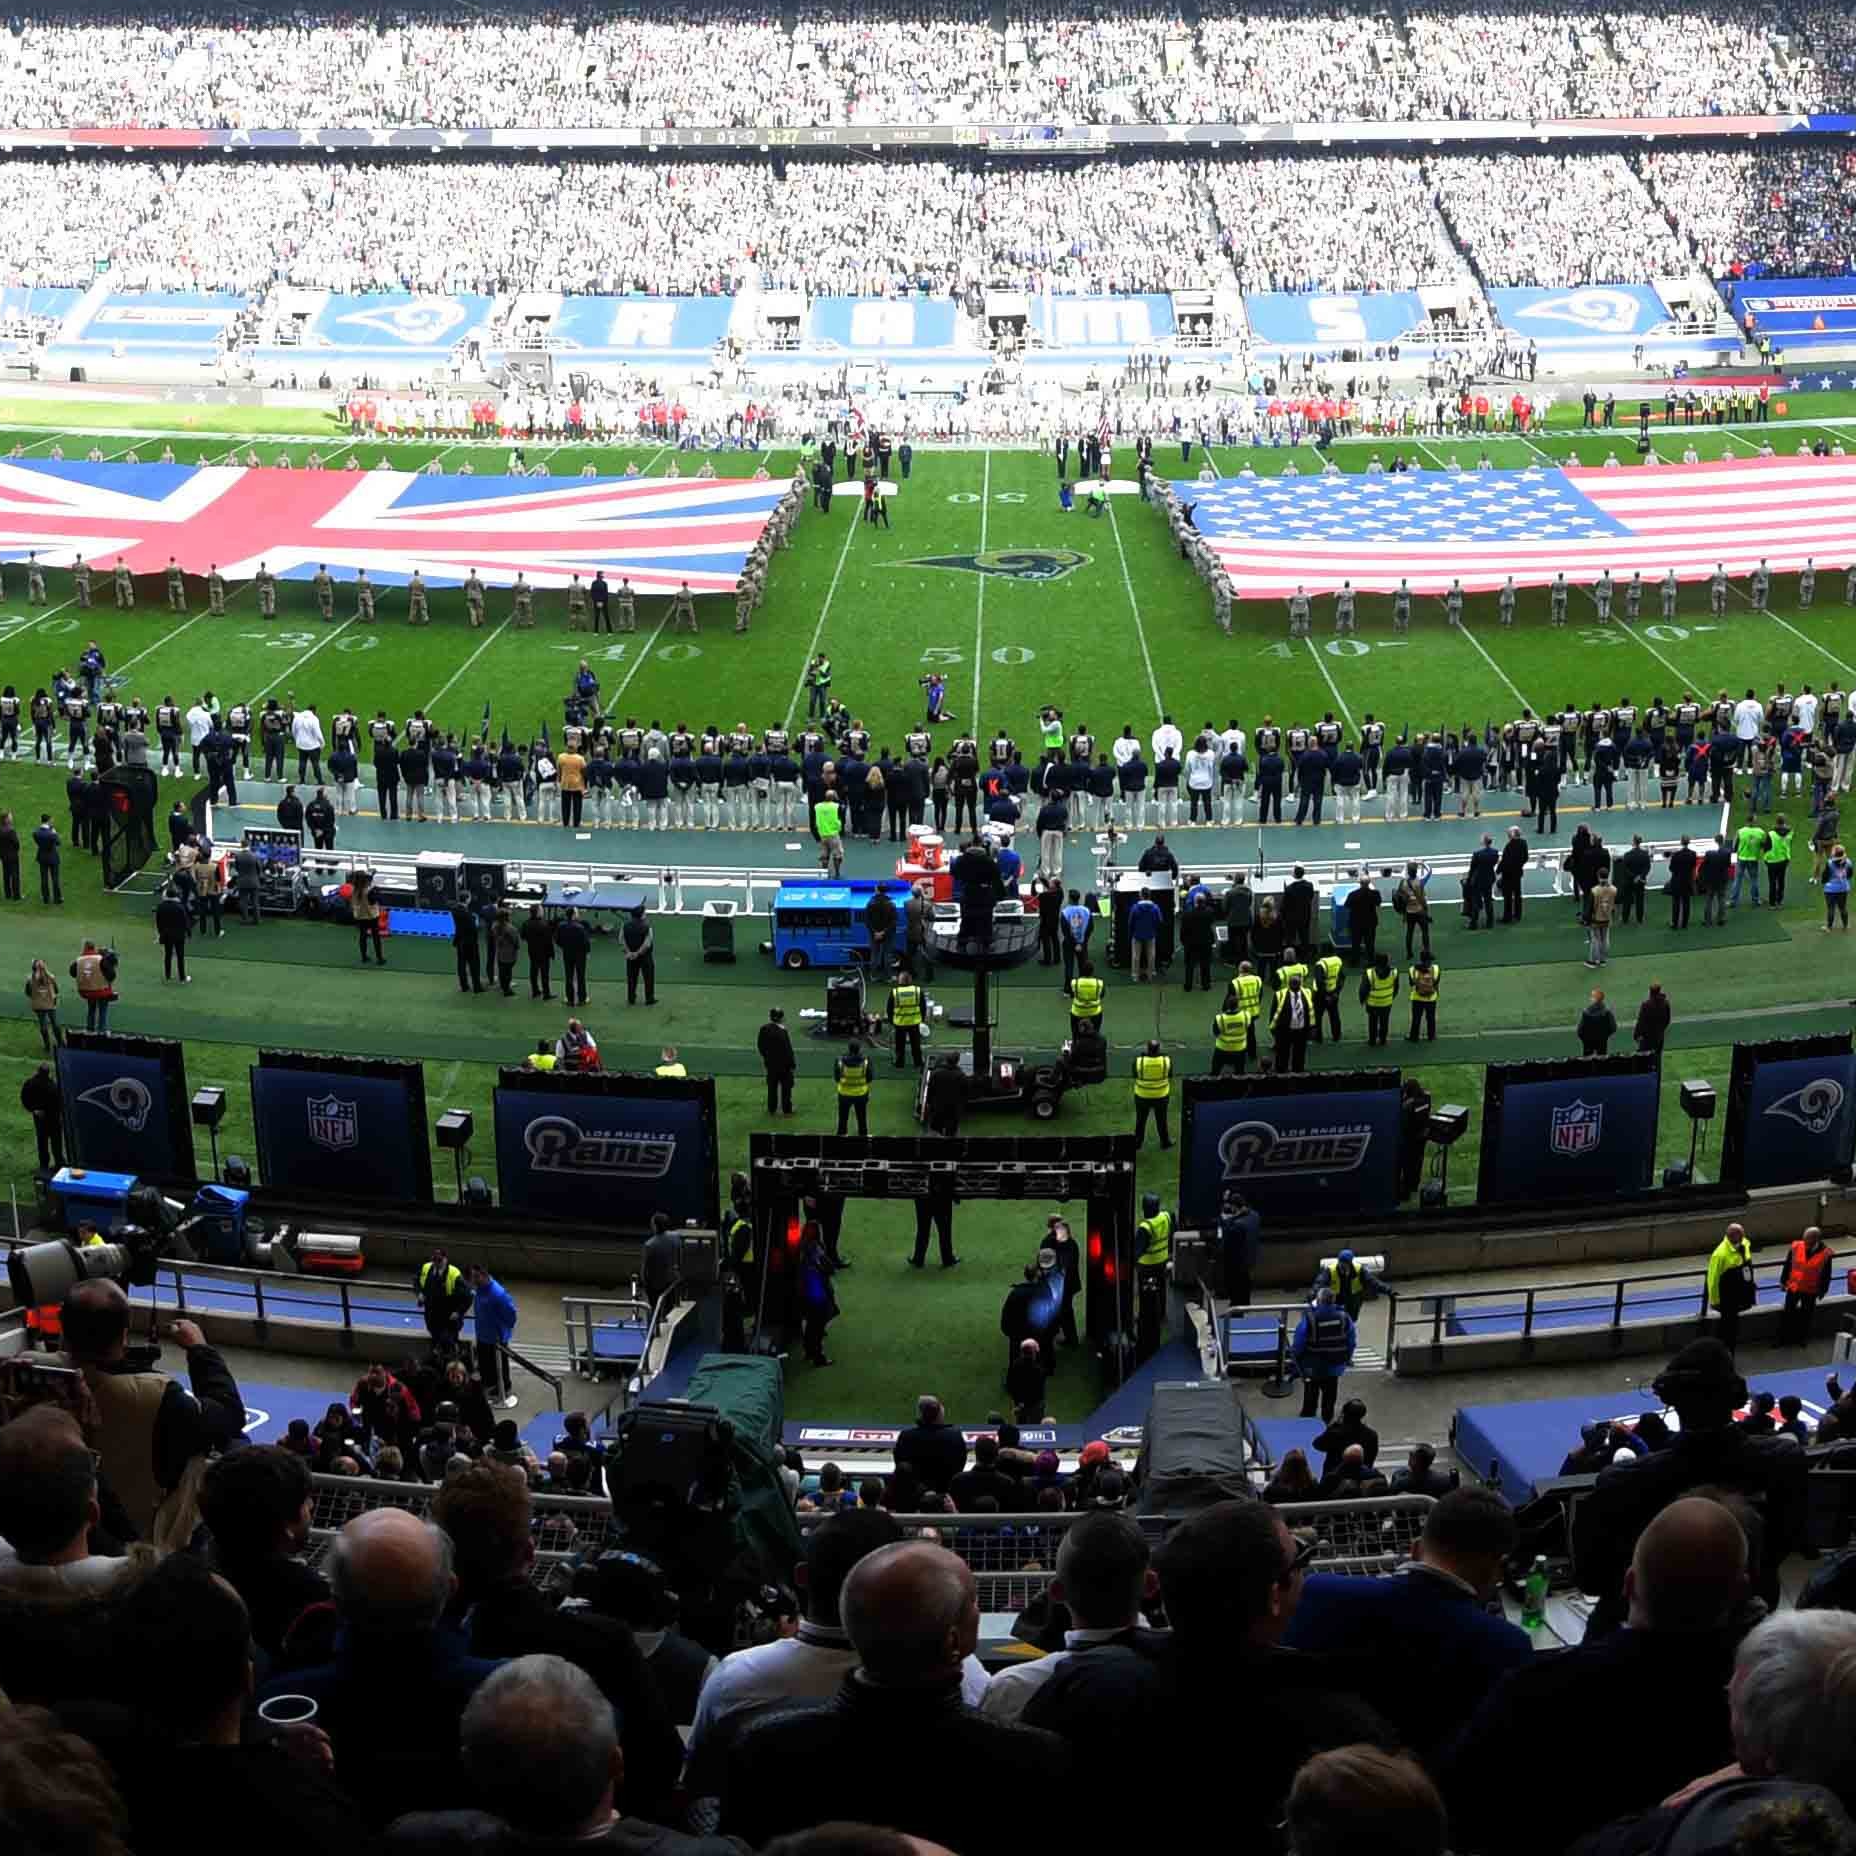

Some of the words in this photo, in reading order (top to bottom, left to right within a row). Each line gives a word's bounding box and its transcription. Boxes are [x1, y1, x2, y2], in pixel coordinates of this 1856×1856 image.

[767, 130, 800, 143] 3:27
[920, 646, 1035, 664] 50
[586, 1129, 611, 1138] LOS
[615, 1131, 676, 1140] ANGELES
[1281, 1129, 1306, 1137] LOS
[1310, 1124, 1372, 1136] ANGELES
